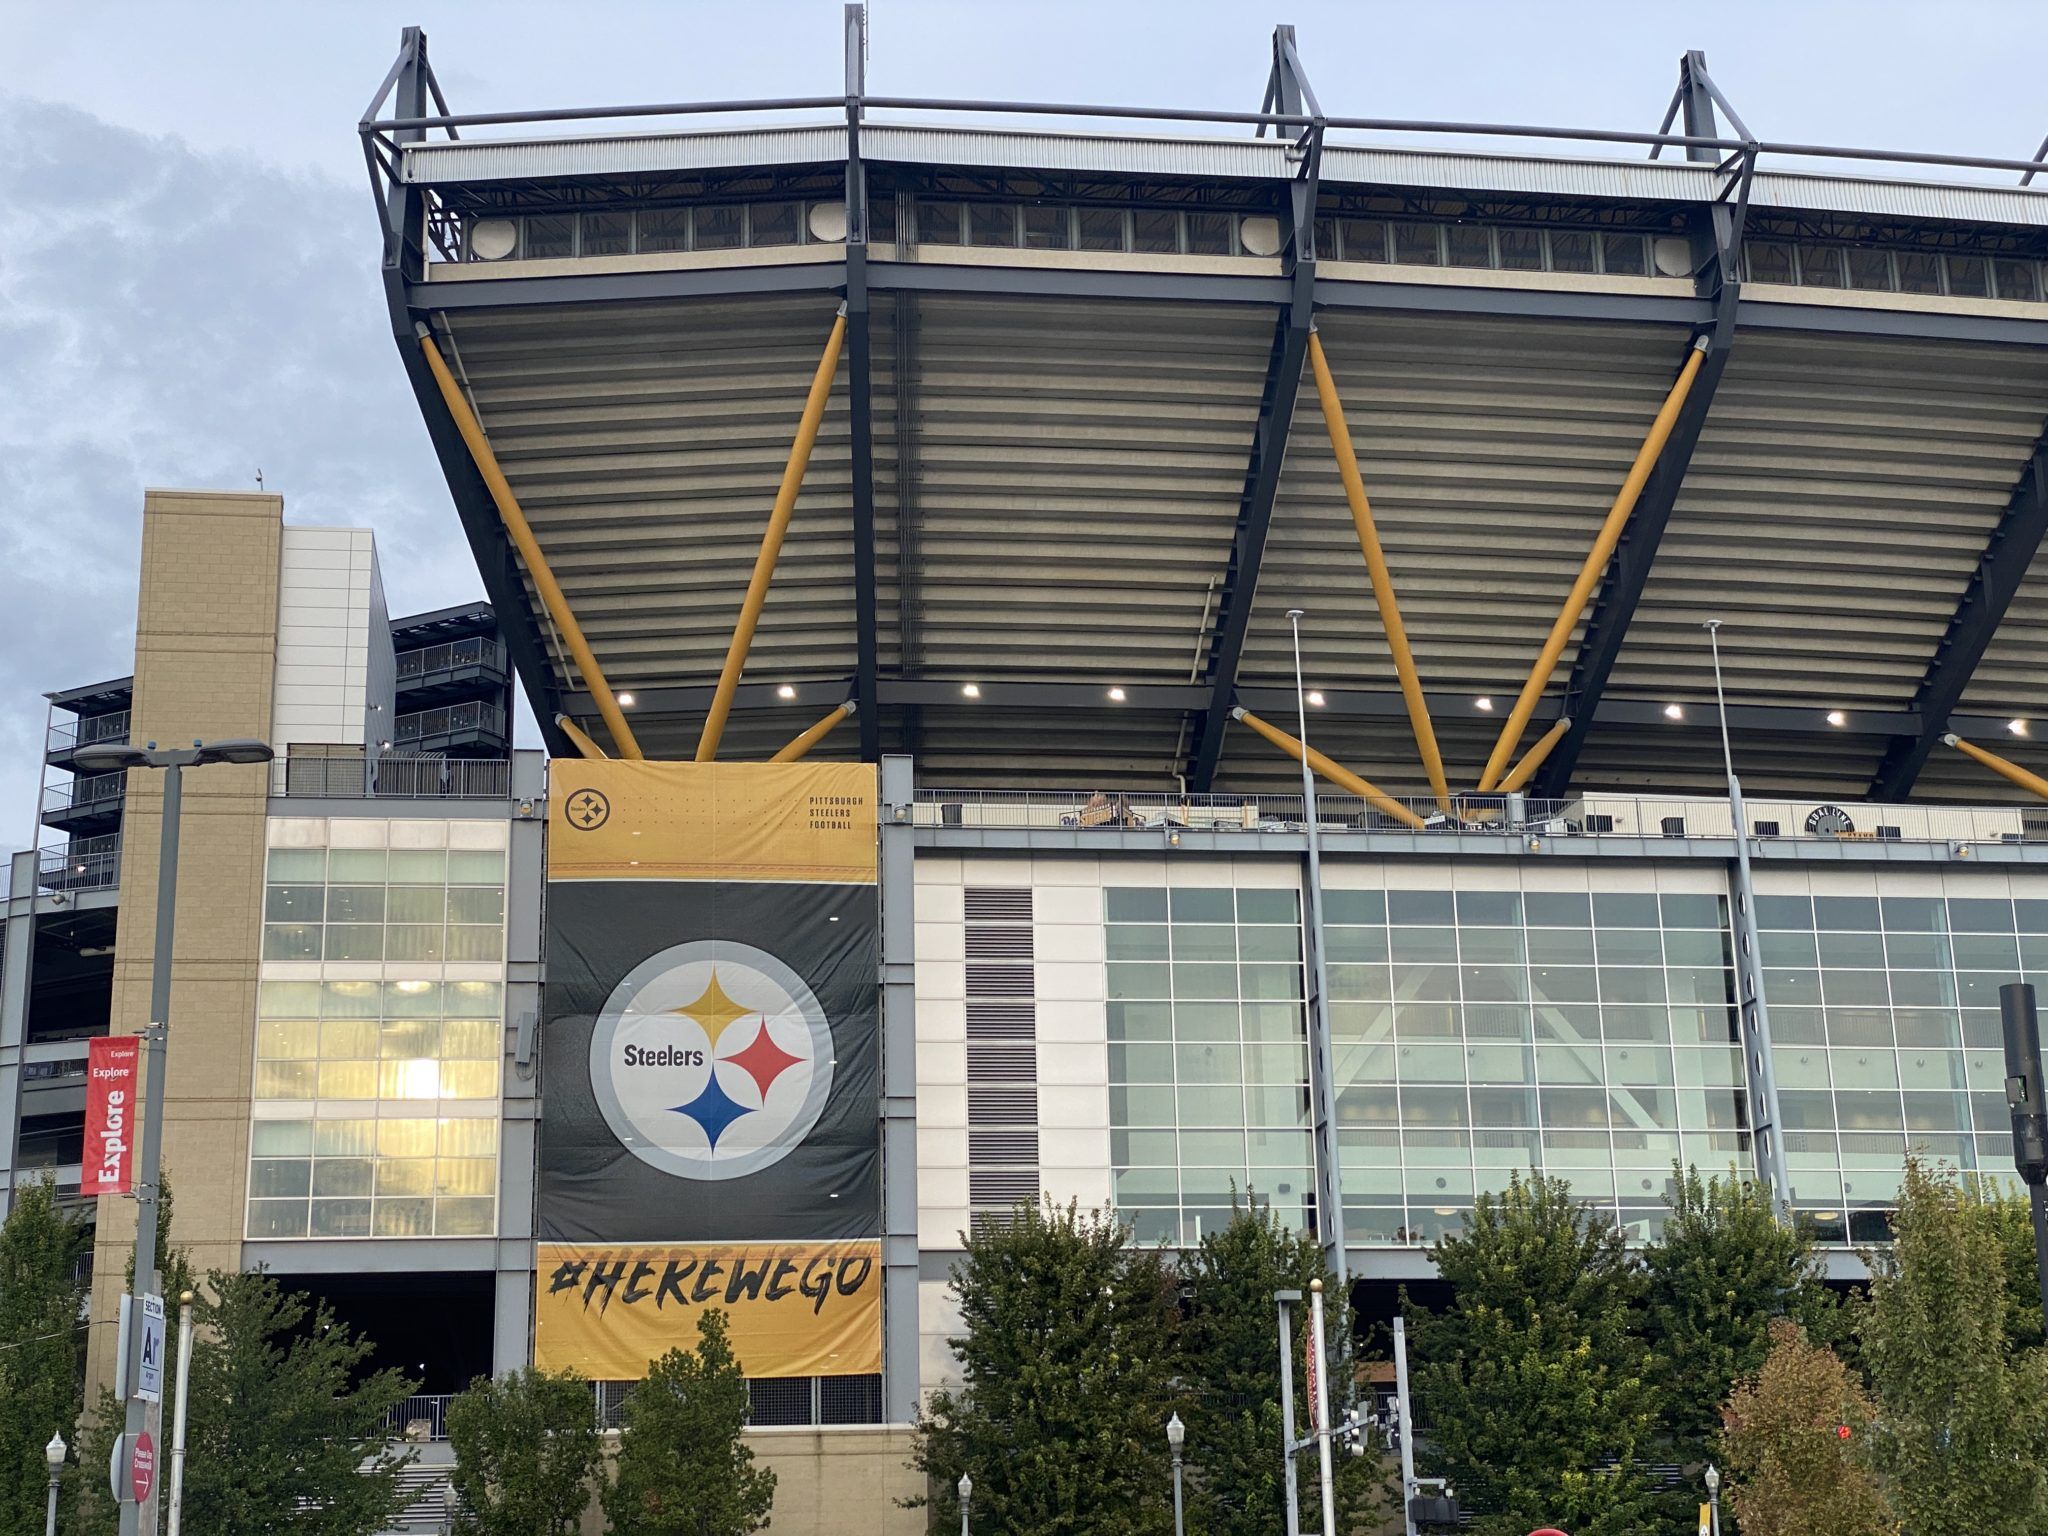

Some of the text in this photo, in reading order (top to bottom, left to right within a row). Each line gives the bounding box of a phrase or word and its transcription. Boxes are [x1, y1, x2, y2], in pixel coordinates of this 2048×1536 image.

[809, 796, 863, 805] PITTSBURGH
[809, 808, 851, 817] STEELERS
[1809, 808, 1851, 825] GOAL LINE
[809, 820, 851, 829] FOOTBALL
[111, 1050, 134, 1058] Explore
[624, 1044, 704, 1066] Steelers
[93, 1067, 129, 1080] Explore
[98, 1090, 127, 1183] Explore
[548, 1246, 872, 1319] #HEREWEGO
[145, 1301, 161, 1314] SECTION
[143, 1327, 160, 1365] Ar
